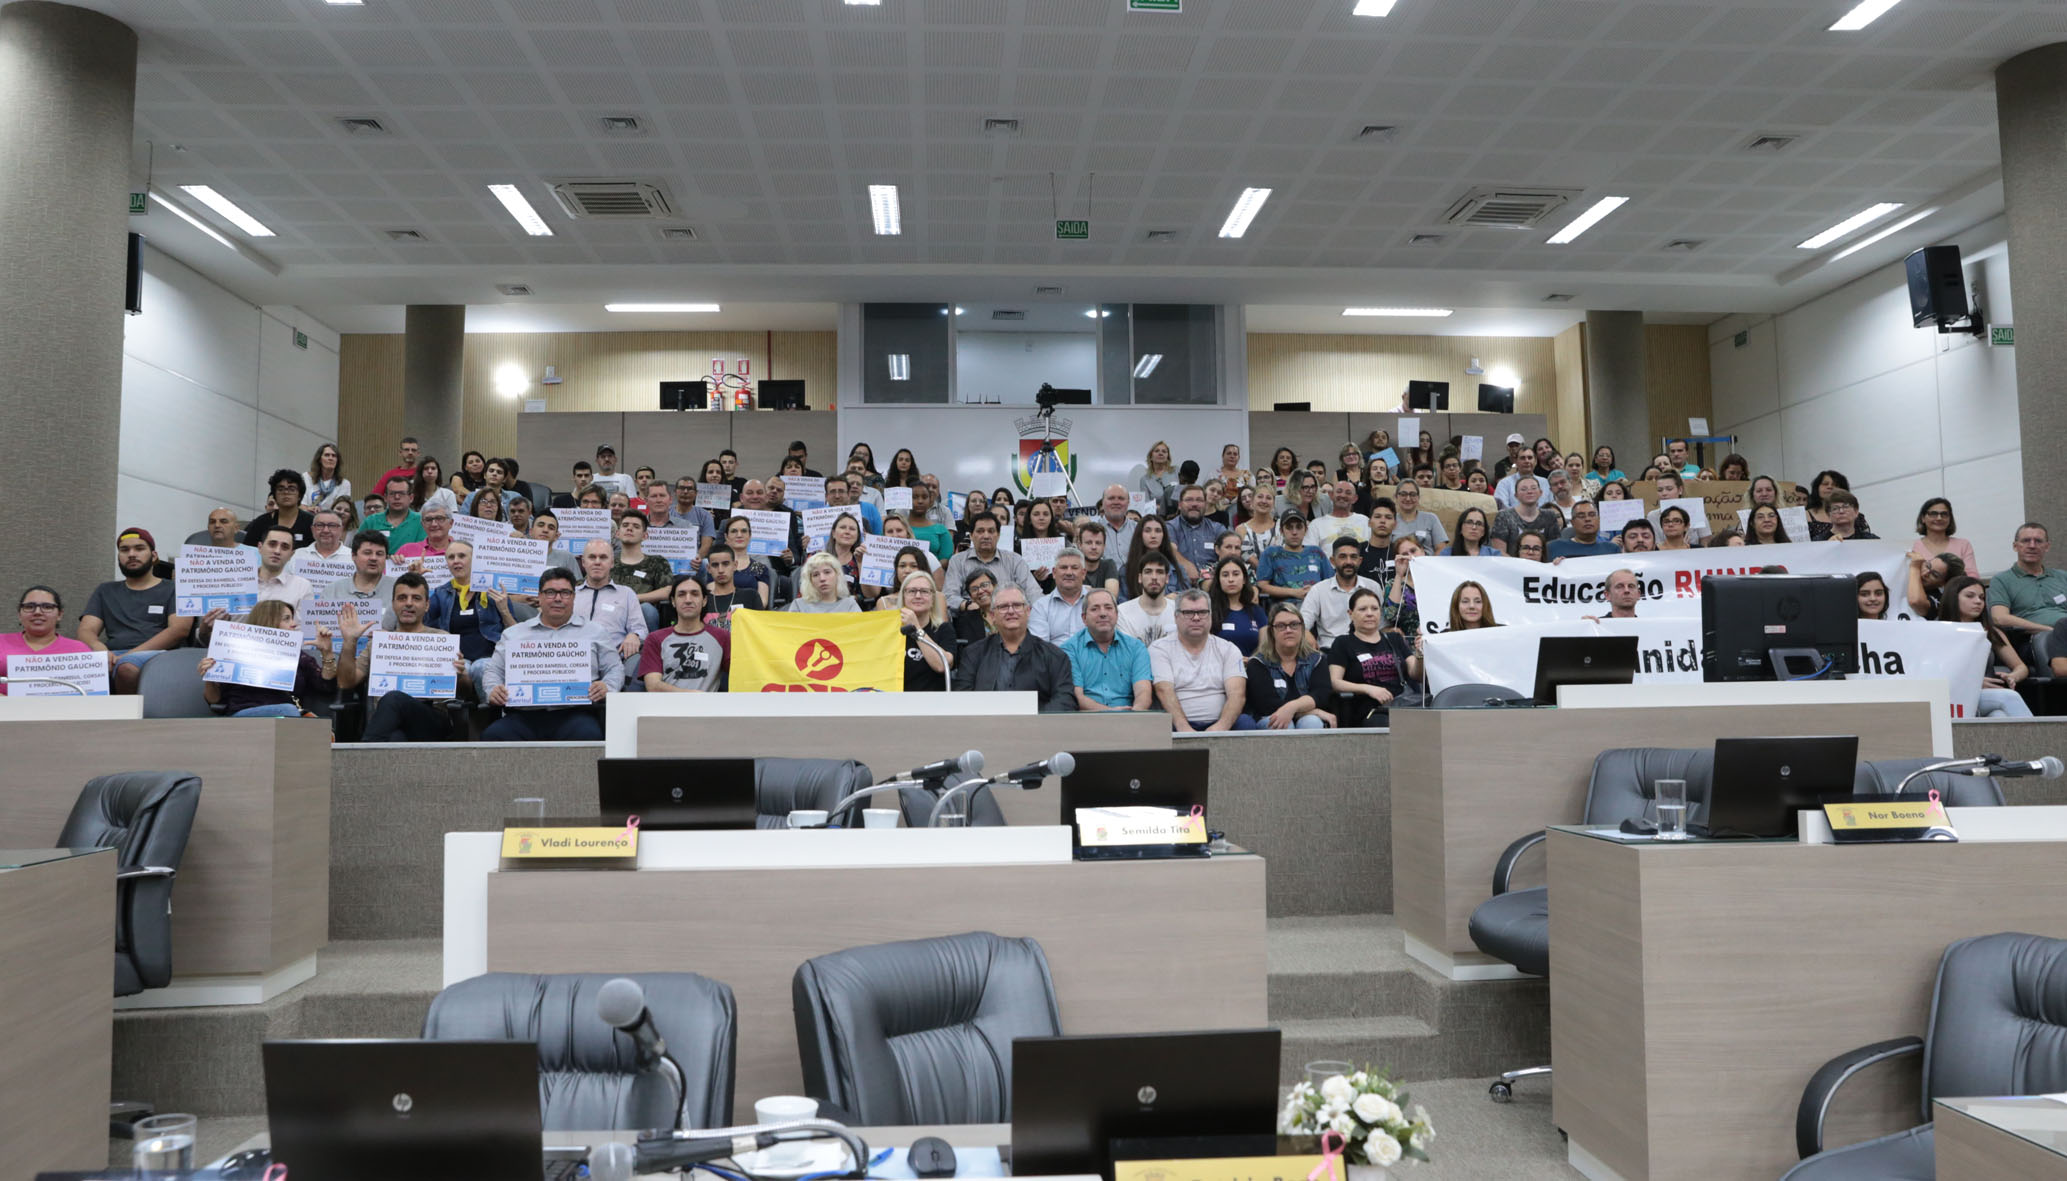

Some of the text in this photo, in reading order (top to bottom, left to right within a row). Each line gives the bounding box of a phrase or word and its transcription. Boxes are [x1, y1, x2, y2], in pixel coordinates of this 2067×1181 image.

[254, 627, 277, 636] VENDA
[265, 638, 297, 647] GAÚCHO!
[379, 642, 422, 651] PATRIMÔNIO
[512, 649, 586, 658] PATRIMÔNIO GAÚCHO!
[15, 661, 102, 672] PATRIMÔNIO GAÚCHO!
[1868, 812, 1888, 820] Nor
[541, 838, 628, 849] Vladi Lourenço
